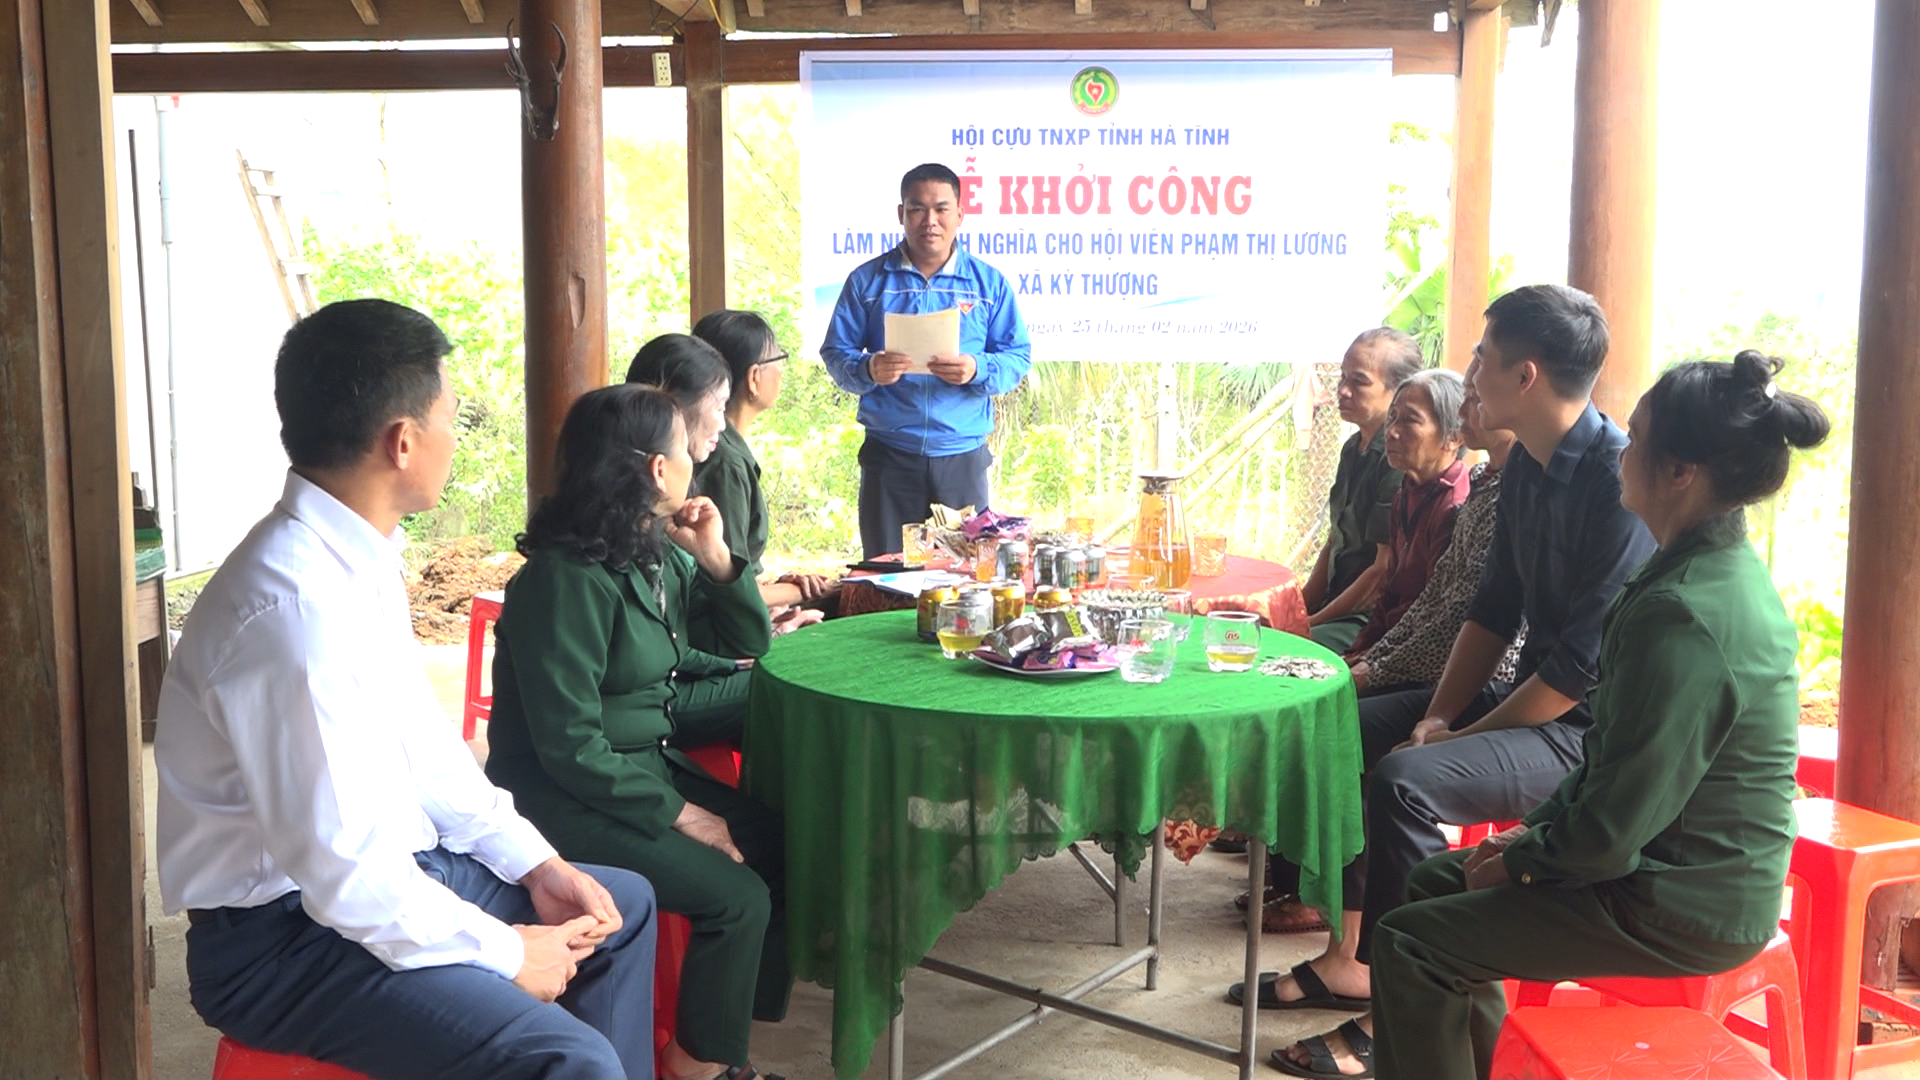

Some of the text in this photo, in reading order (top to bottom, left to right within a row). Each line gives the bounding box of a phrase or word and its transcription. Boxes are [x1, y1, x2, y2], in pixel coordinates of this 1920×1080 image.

[952, 122, 1230, 150] HỘI CỰU TNXP TỈNH HÀ TĨNH
[957, 156, 1252, 216] Ễ KHỞI CÔNG
[833, 228, 873, 255] LÀM
[978, 228, 1038, 255] NGHĨA
[1045, 232, 1083, 255] CHO
[1091, 228, 1122, 260] HỘI
[1130, 228, 1174, 255] VIÊN
[1181, 232, 1239, 260] PHẠM
[1246, 232, 1276, 260] THỊ
[1283, 231, 1347, 256] LƯƠNG
[1018, 268, 1043, 295] XÃ
[1081, 271, 1158, 301] THƯỢNG
[1072, 319, 1091, 334] 25
[1151, 320, 1171, 334] 02
[1218, 320, 1258, 335] 2026
